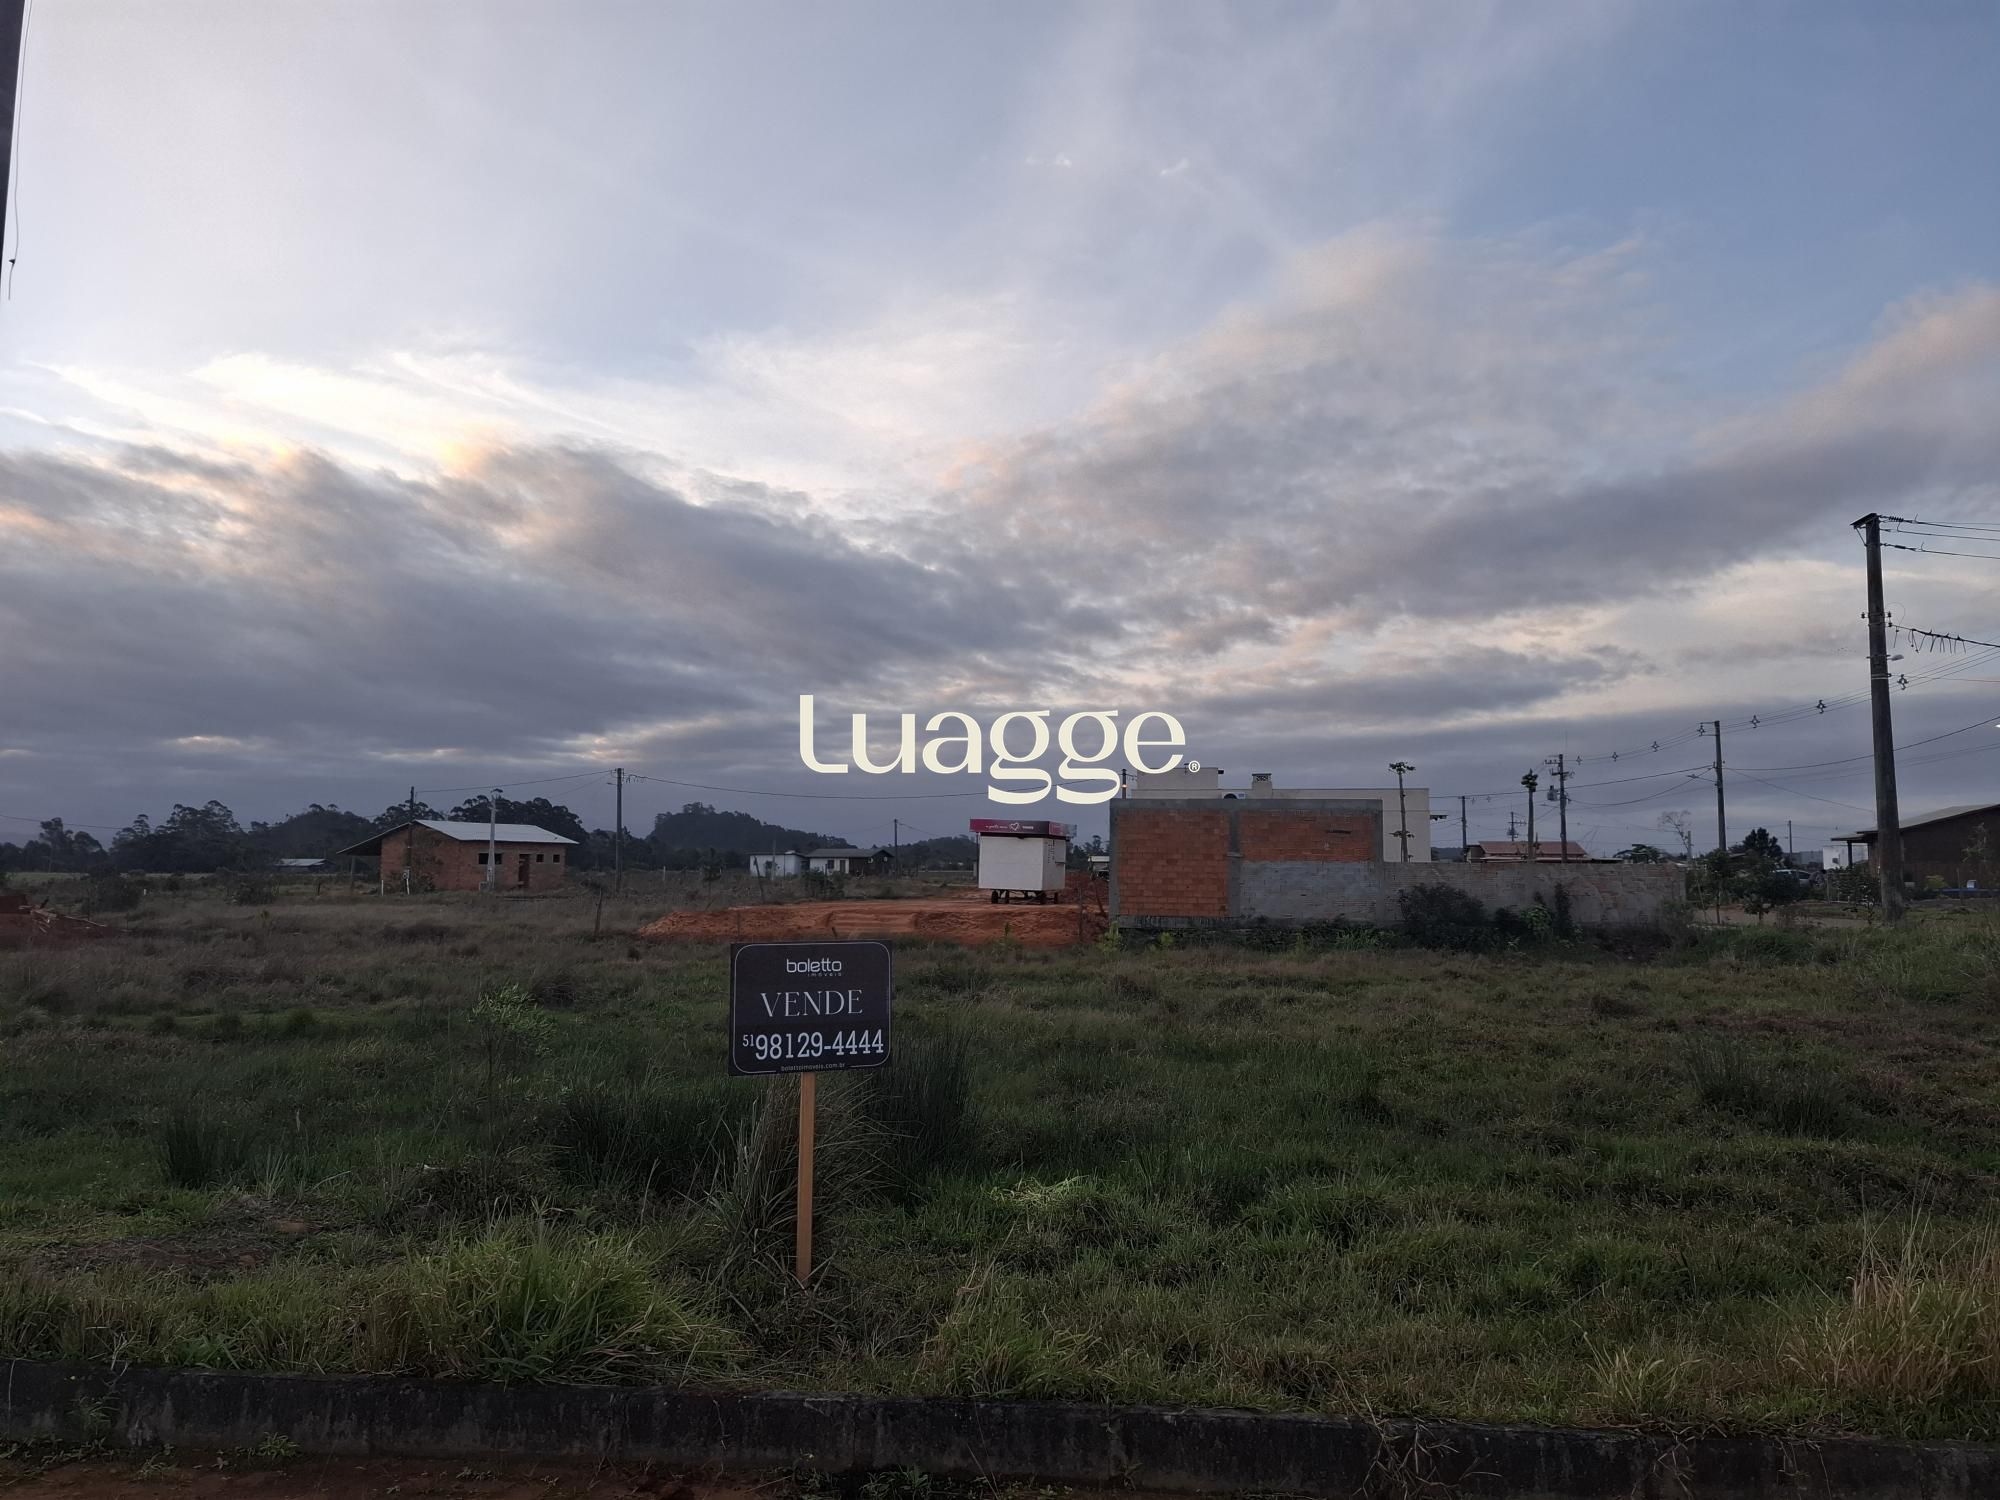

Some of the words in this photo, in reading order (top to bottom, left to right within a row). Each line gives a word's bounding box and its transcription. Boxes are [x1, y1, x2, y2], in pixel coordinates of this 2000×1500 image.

[786, 958, 842, 973] boletto
[760, 989, 863, 1017] VENDE
[755, 1029, 884, 1060] 98129-4444
